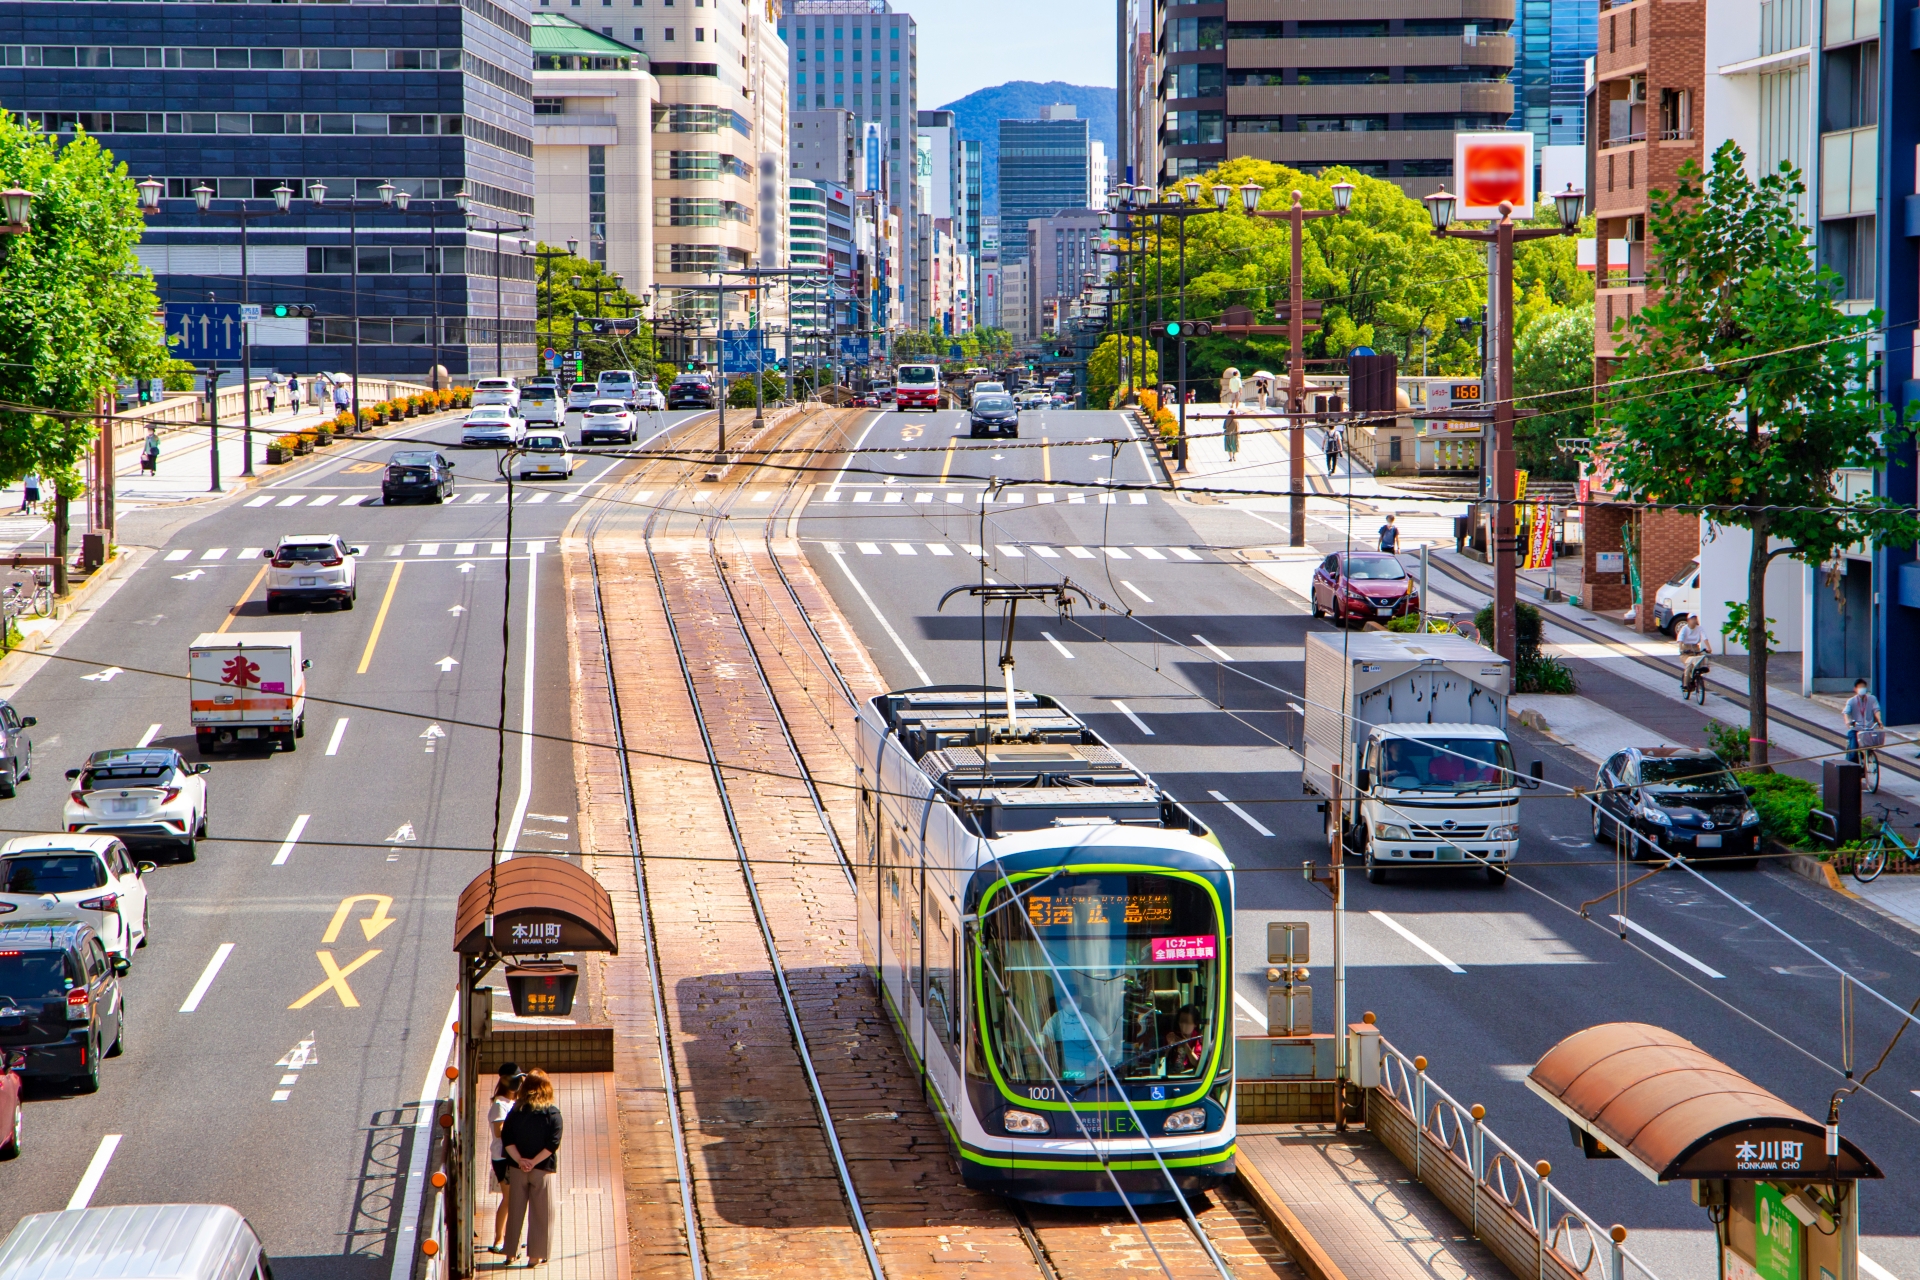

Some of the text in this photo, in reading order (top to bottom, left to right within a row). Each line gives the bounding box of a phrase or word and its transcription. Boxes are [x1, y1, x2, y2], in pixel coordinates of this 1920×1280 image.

[1456, 385, 1478, 399] 168
[221, 655, 261, 687] 氷
[511, 923, 561, 938] 本川町
[1166, 938, 1204, 948] ICカード
[1155, 947, 1214, 960] 全扉降車車両
[527, 994, 555, 1004] 電車が
[528, 1004, 555, 1012] きます
[1028, 1087, 1055, 1100] 1001
[1104, 1117, 1141, 1132] LEX
[1735, 1140, 1804, 1161] 本川町
[1737, 1162, 1800, 1170] HONKAWA CHO
